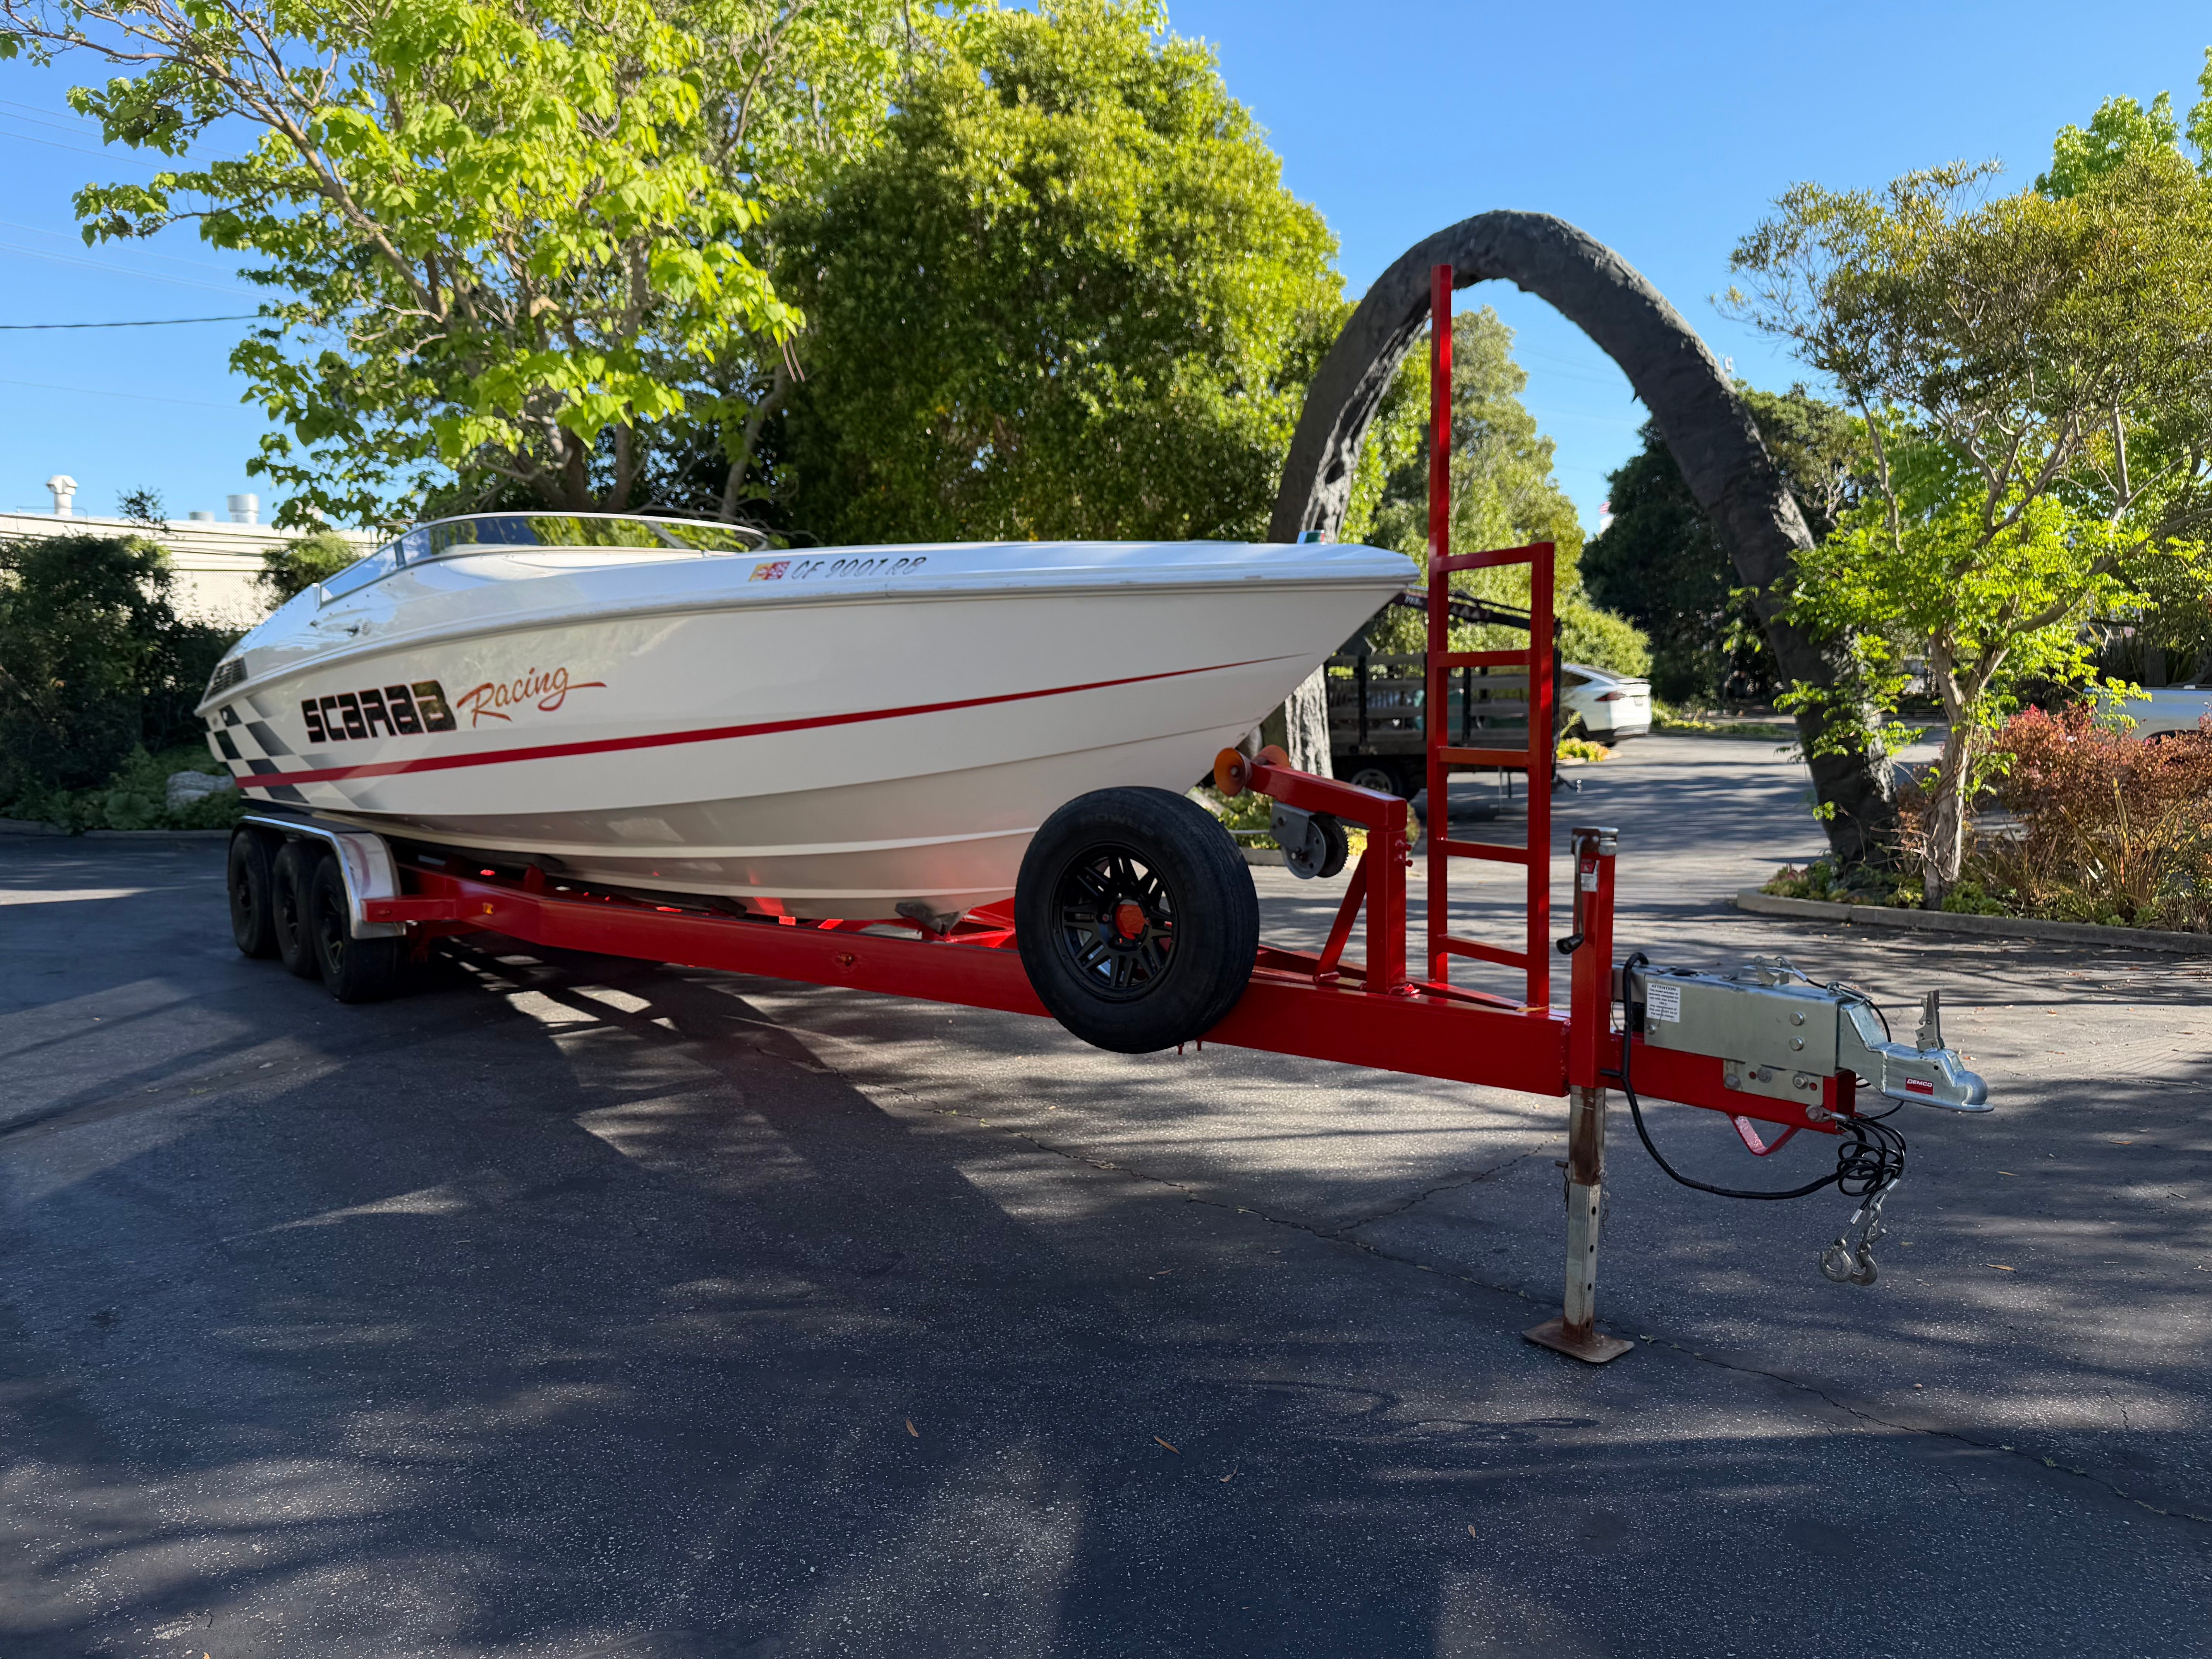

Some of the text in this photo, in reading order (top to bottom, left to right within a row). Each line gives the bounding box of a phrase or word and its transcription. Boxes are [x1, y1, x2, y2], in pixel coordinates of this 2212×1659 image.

[791, 560, 825, 580] CF
[825, 558, 889, 578] 9001
[885, 556, 927, 575] RB
[457, 667, 607, 728] Racing
[1080, 813, 1154, 838] POWER
[1907, 1079, 1932, 1087] DEMCO
